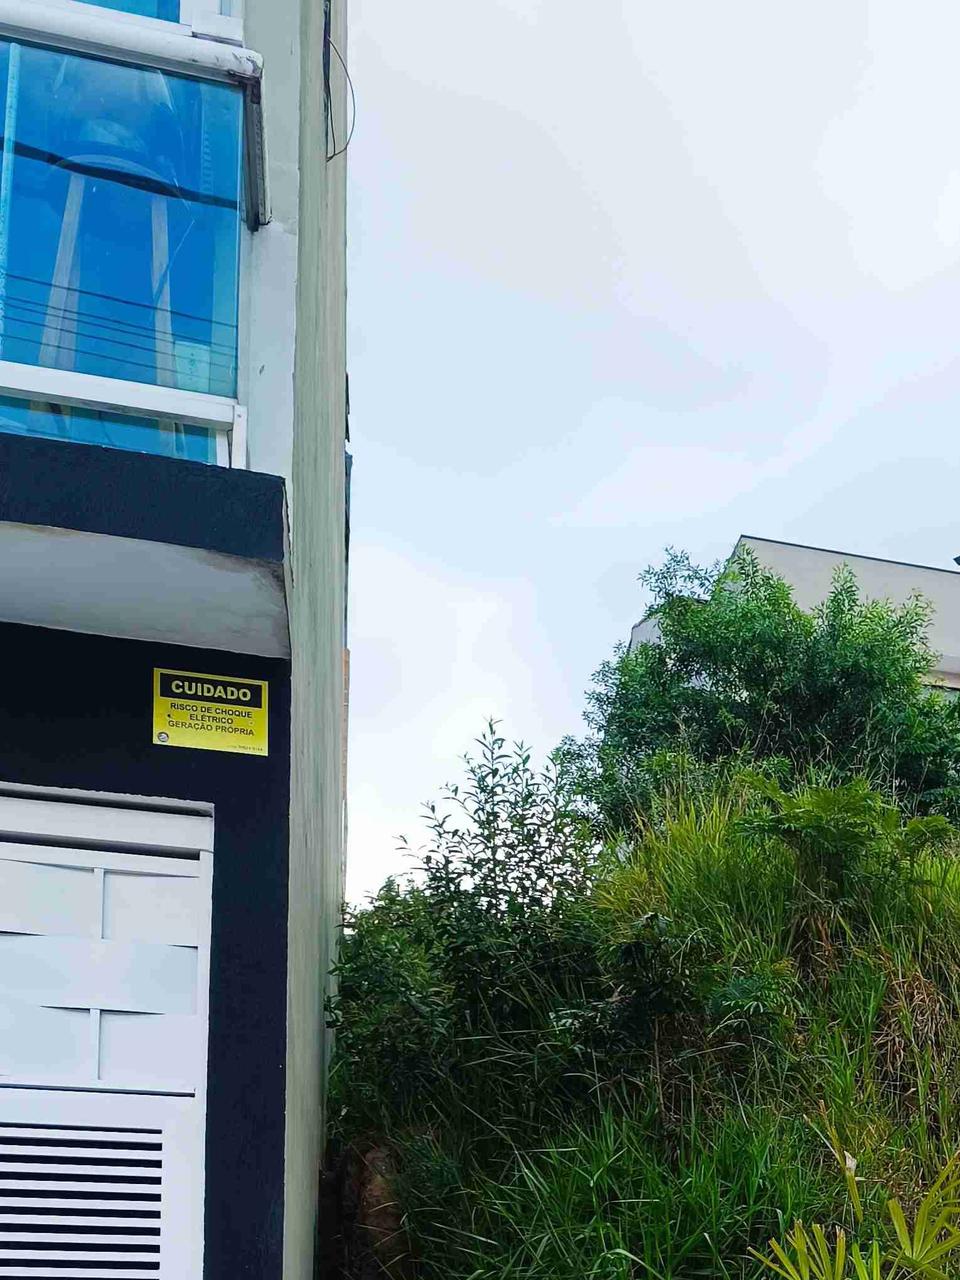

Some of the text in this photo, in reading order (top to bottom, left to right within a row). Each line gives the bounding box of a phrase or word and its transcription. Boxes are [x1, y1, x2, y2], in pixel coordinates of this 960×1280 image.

[171, 680, 251, 701] CUIDADO
[170, 702, 253, 718] RISCO DE CHOQUE
[168, 720, 213, 732] GERAÇÃO
